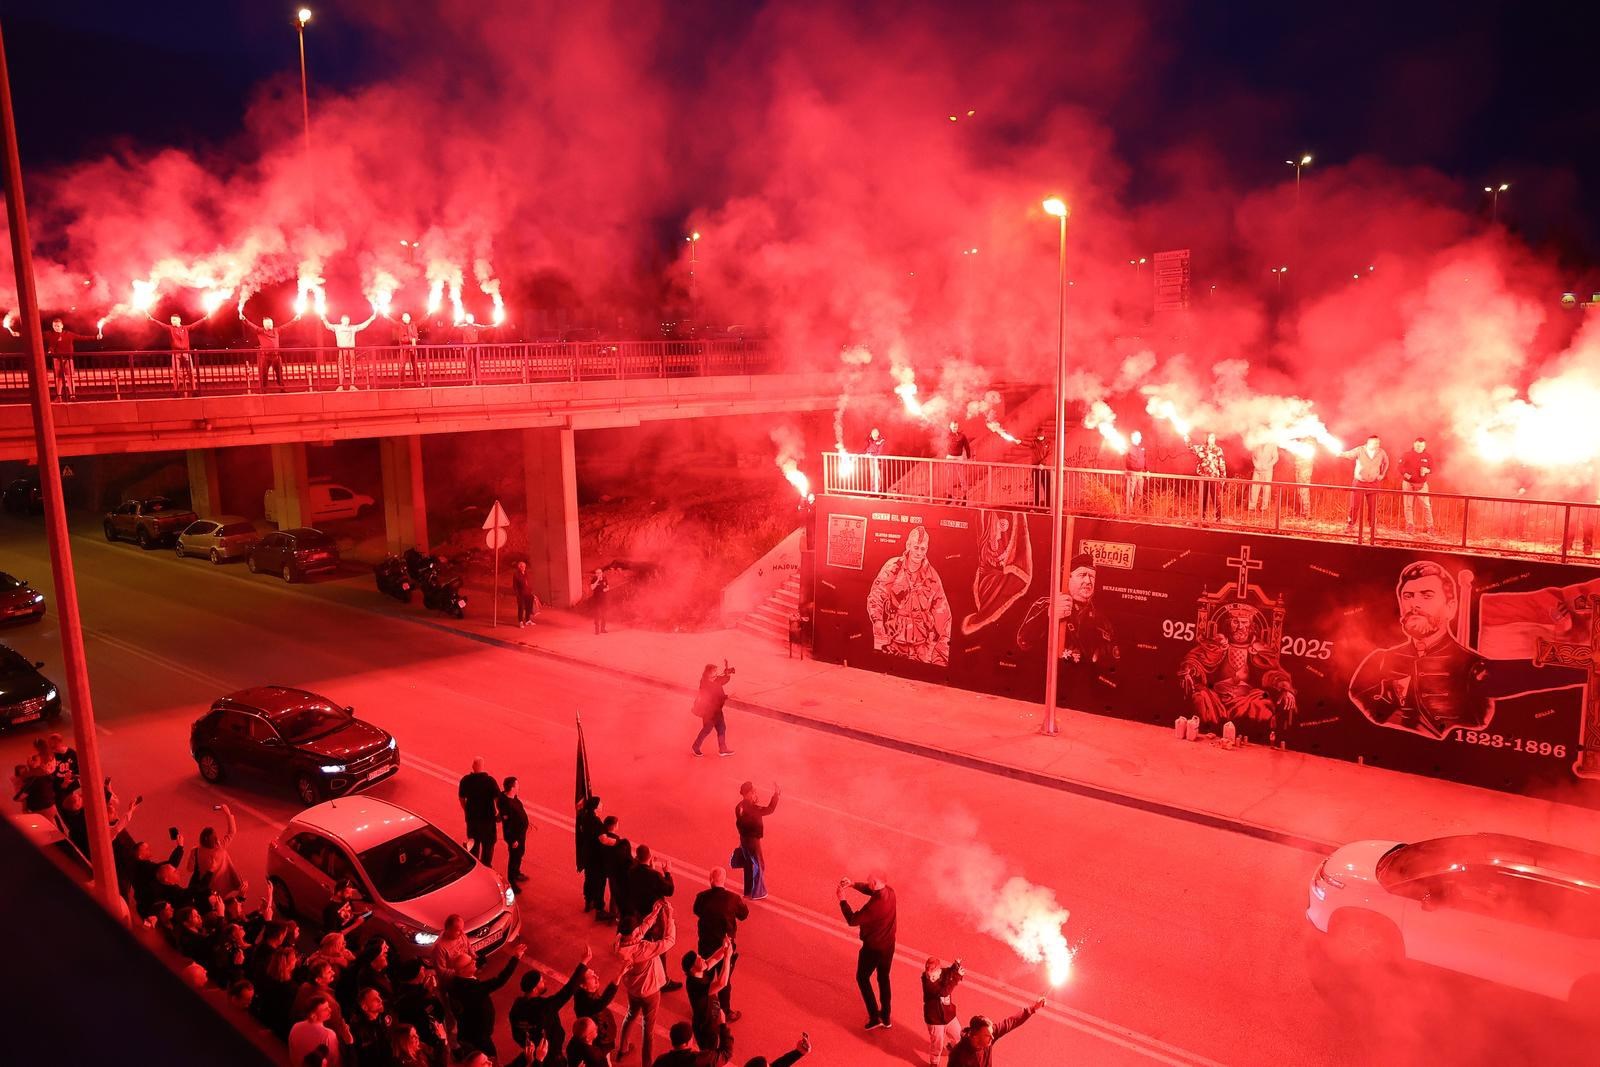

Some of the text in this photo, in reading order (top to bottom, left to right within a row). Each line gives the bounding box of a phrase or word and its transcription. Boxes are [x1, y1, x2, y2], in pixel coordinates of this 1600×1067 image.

[1162, 619, 1196, 641] 925
[1280, 636, 1334, 660] 2025
[1455, 729, 1566, 758] 1823-1896
